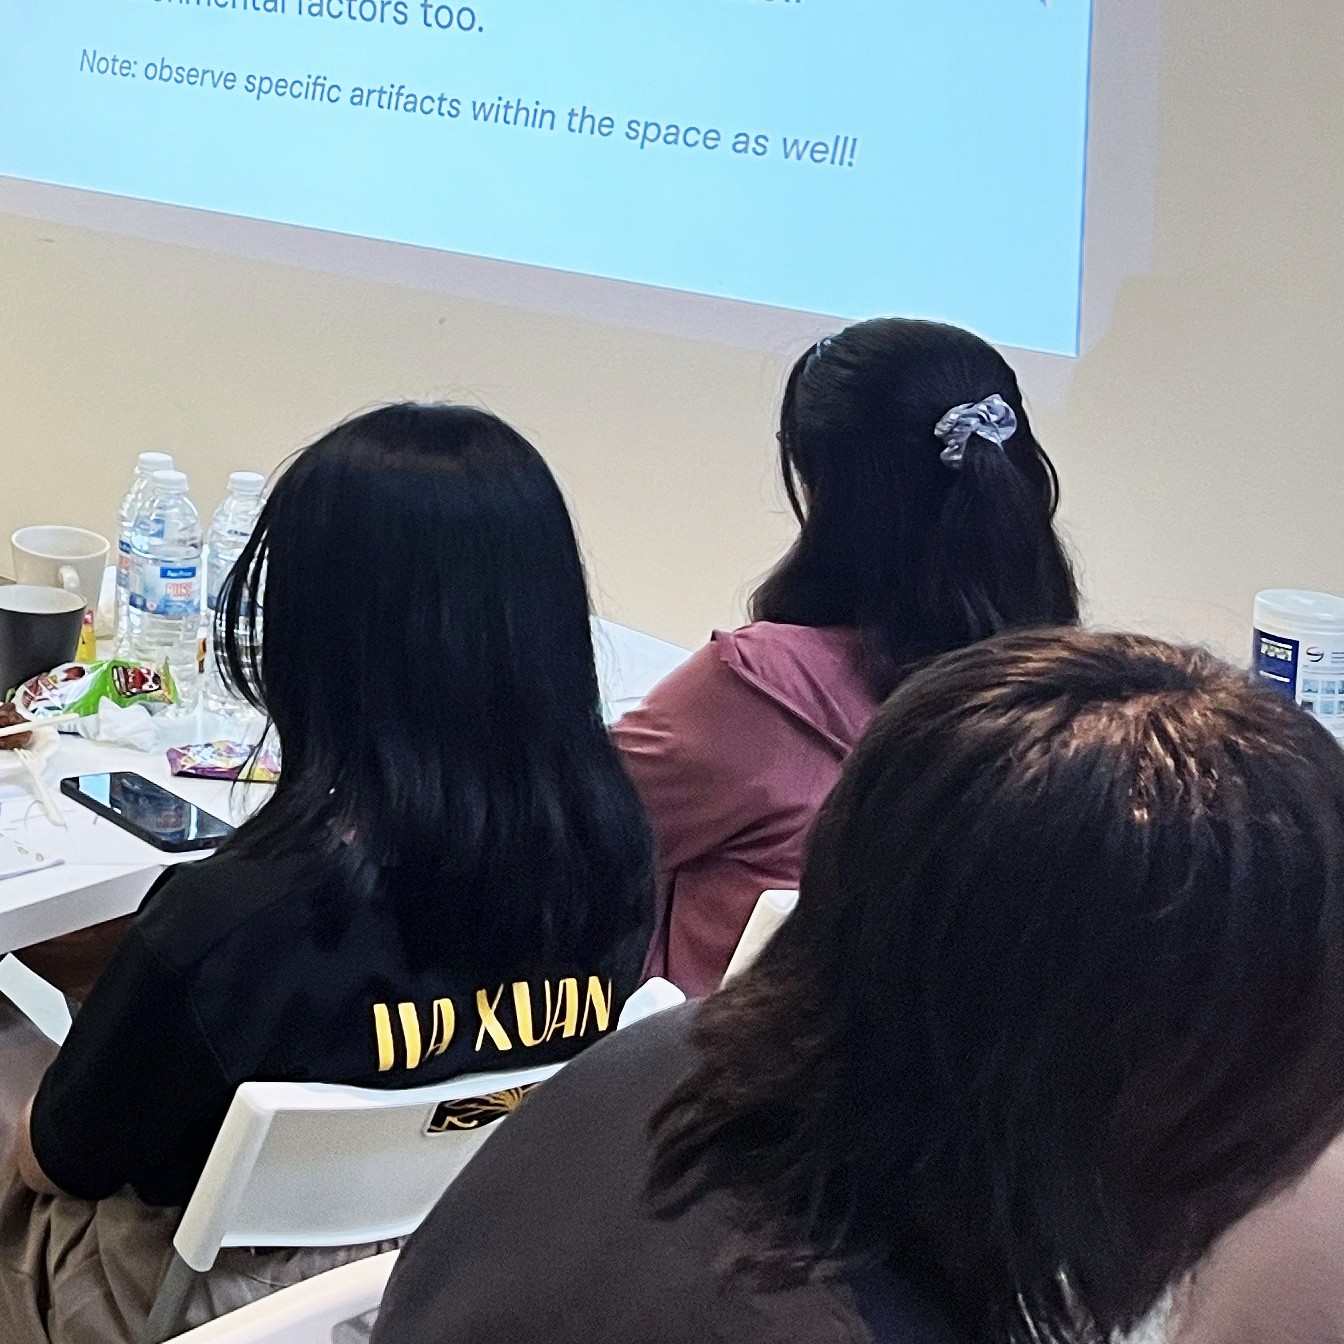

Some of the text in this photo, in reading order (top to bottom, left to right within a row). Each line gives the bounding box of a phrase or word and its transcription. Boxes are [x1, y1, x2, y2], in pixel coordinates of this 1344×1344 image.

[79, 48, 859, 168] Note: observe specific artifacts within the space as well!
[474, 975, 612, 1052] XUAN
